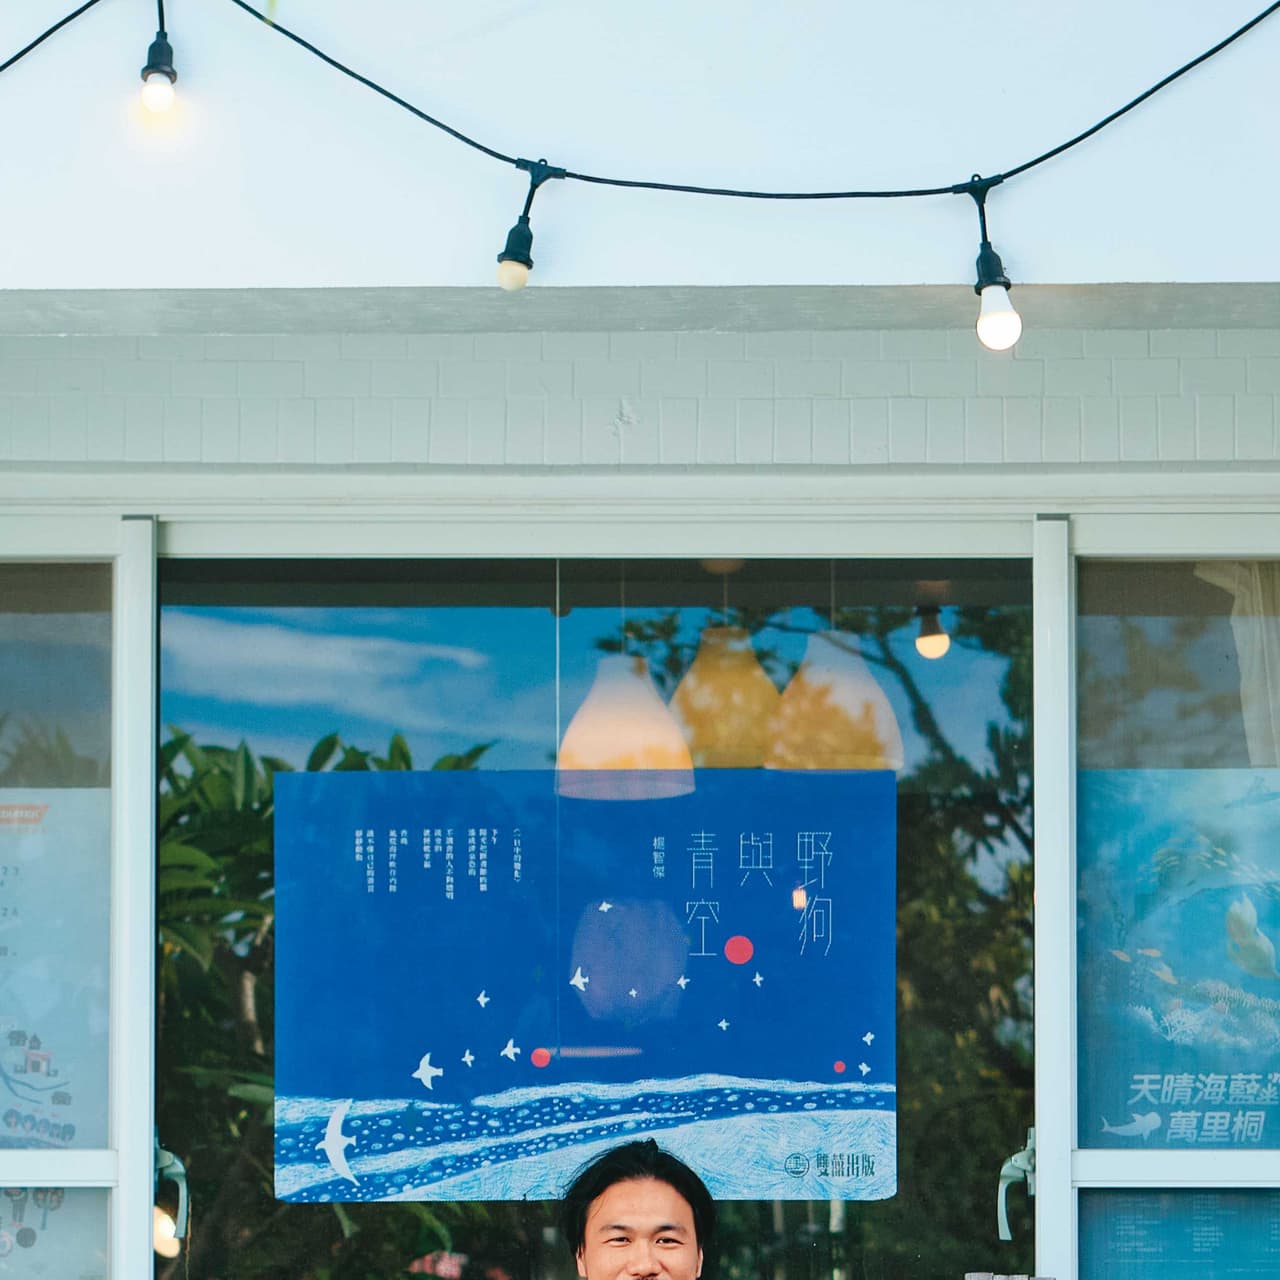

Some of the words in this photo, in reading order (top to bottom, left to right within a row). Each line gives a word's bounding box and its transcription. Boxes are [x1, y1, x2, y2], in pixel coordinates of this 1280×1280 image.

[686, 829, 719, 956] 青空
[739, 832, 773, 887] 與
[797, 831, 833, 956] 野狗
[1165, 1110, 1265, 1143] 萬里桐
